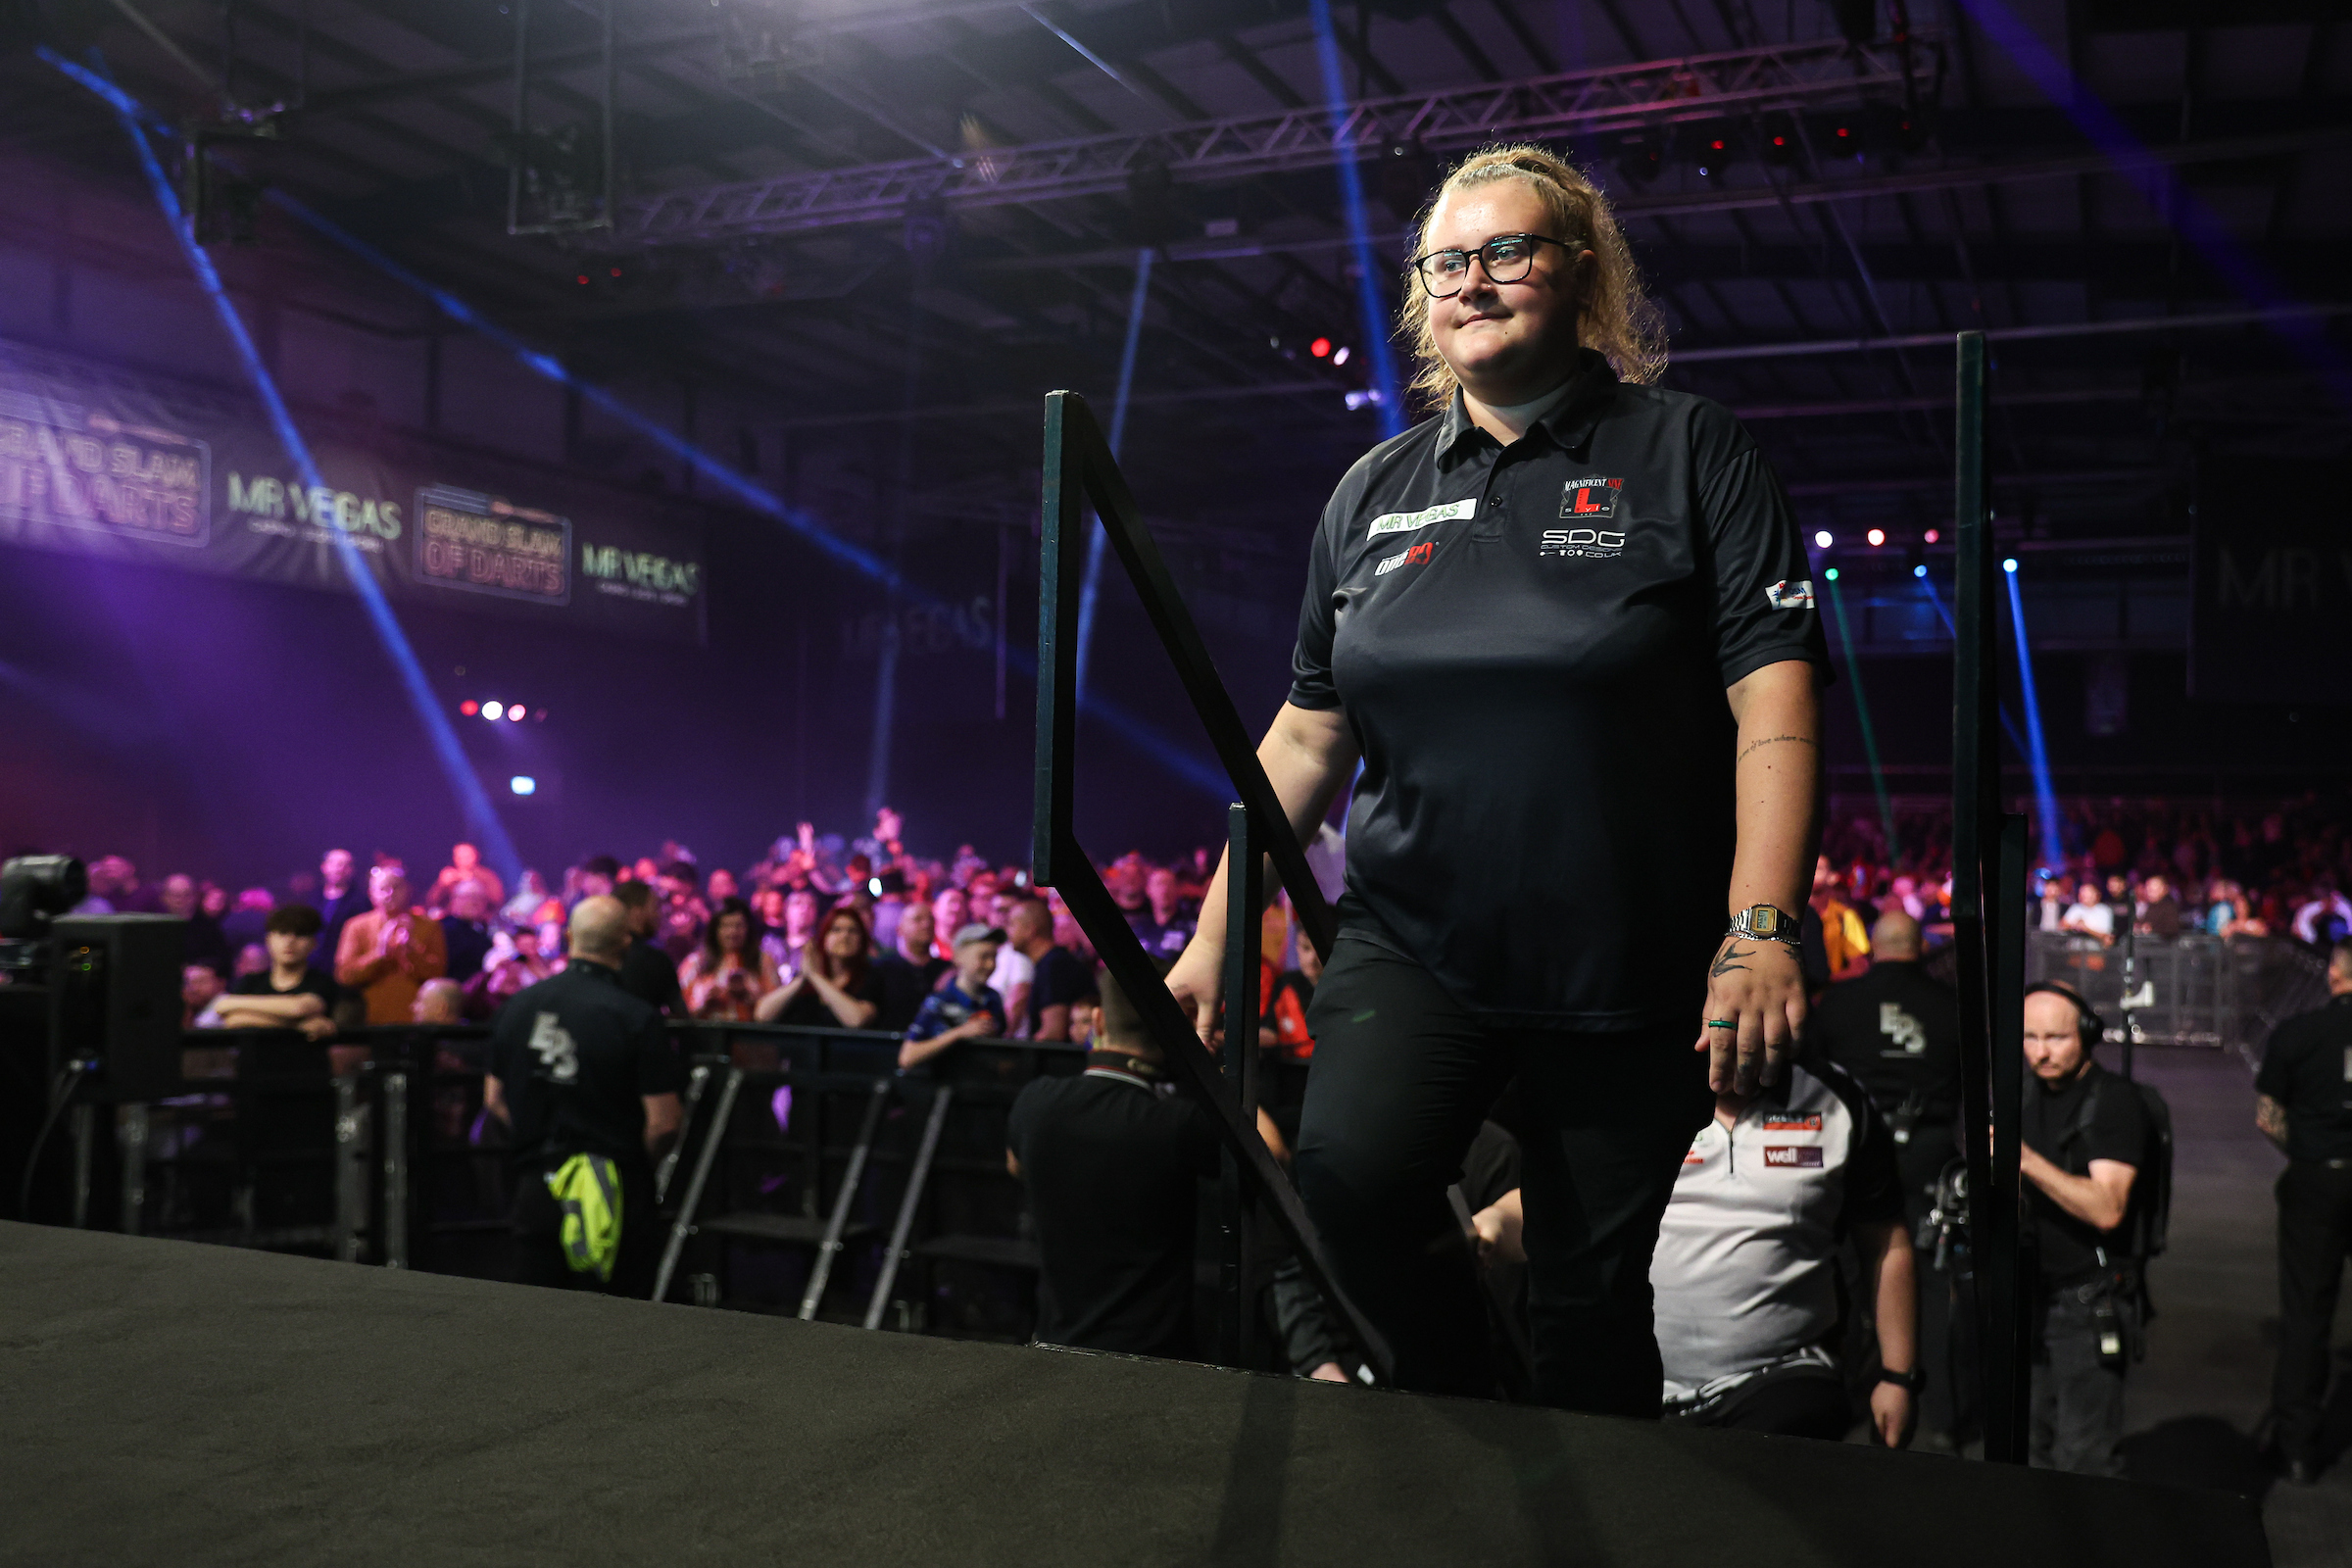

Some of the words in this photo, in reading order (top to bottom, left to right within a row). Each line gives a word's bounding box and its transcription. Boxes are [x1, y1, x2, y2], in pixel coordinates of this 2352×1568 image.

[227, 470, 286, 517] MR
[287, 481, 402, 540] VEGAS
[1377, 514, 1402, 531] MR
[1406, 504, 1459, 528] VEGAS
[1542, 529, 1626, 547] SDG
[424, 541, 465, 579] OF
[467, 546, 564, 596] DARTS
[623, 550, 700, 596] VEGAS
[2217, 545, 2321, 610] MR
[1767, 1147, 1797, 1163] well
